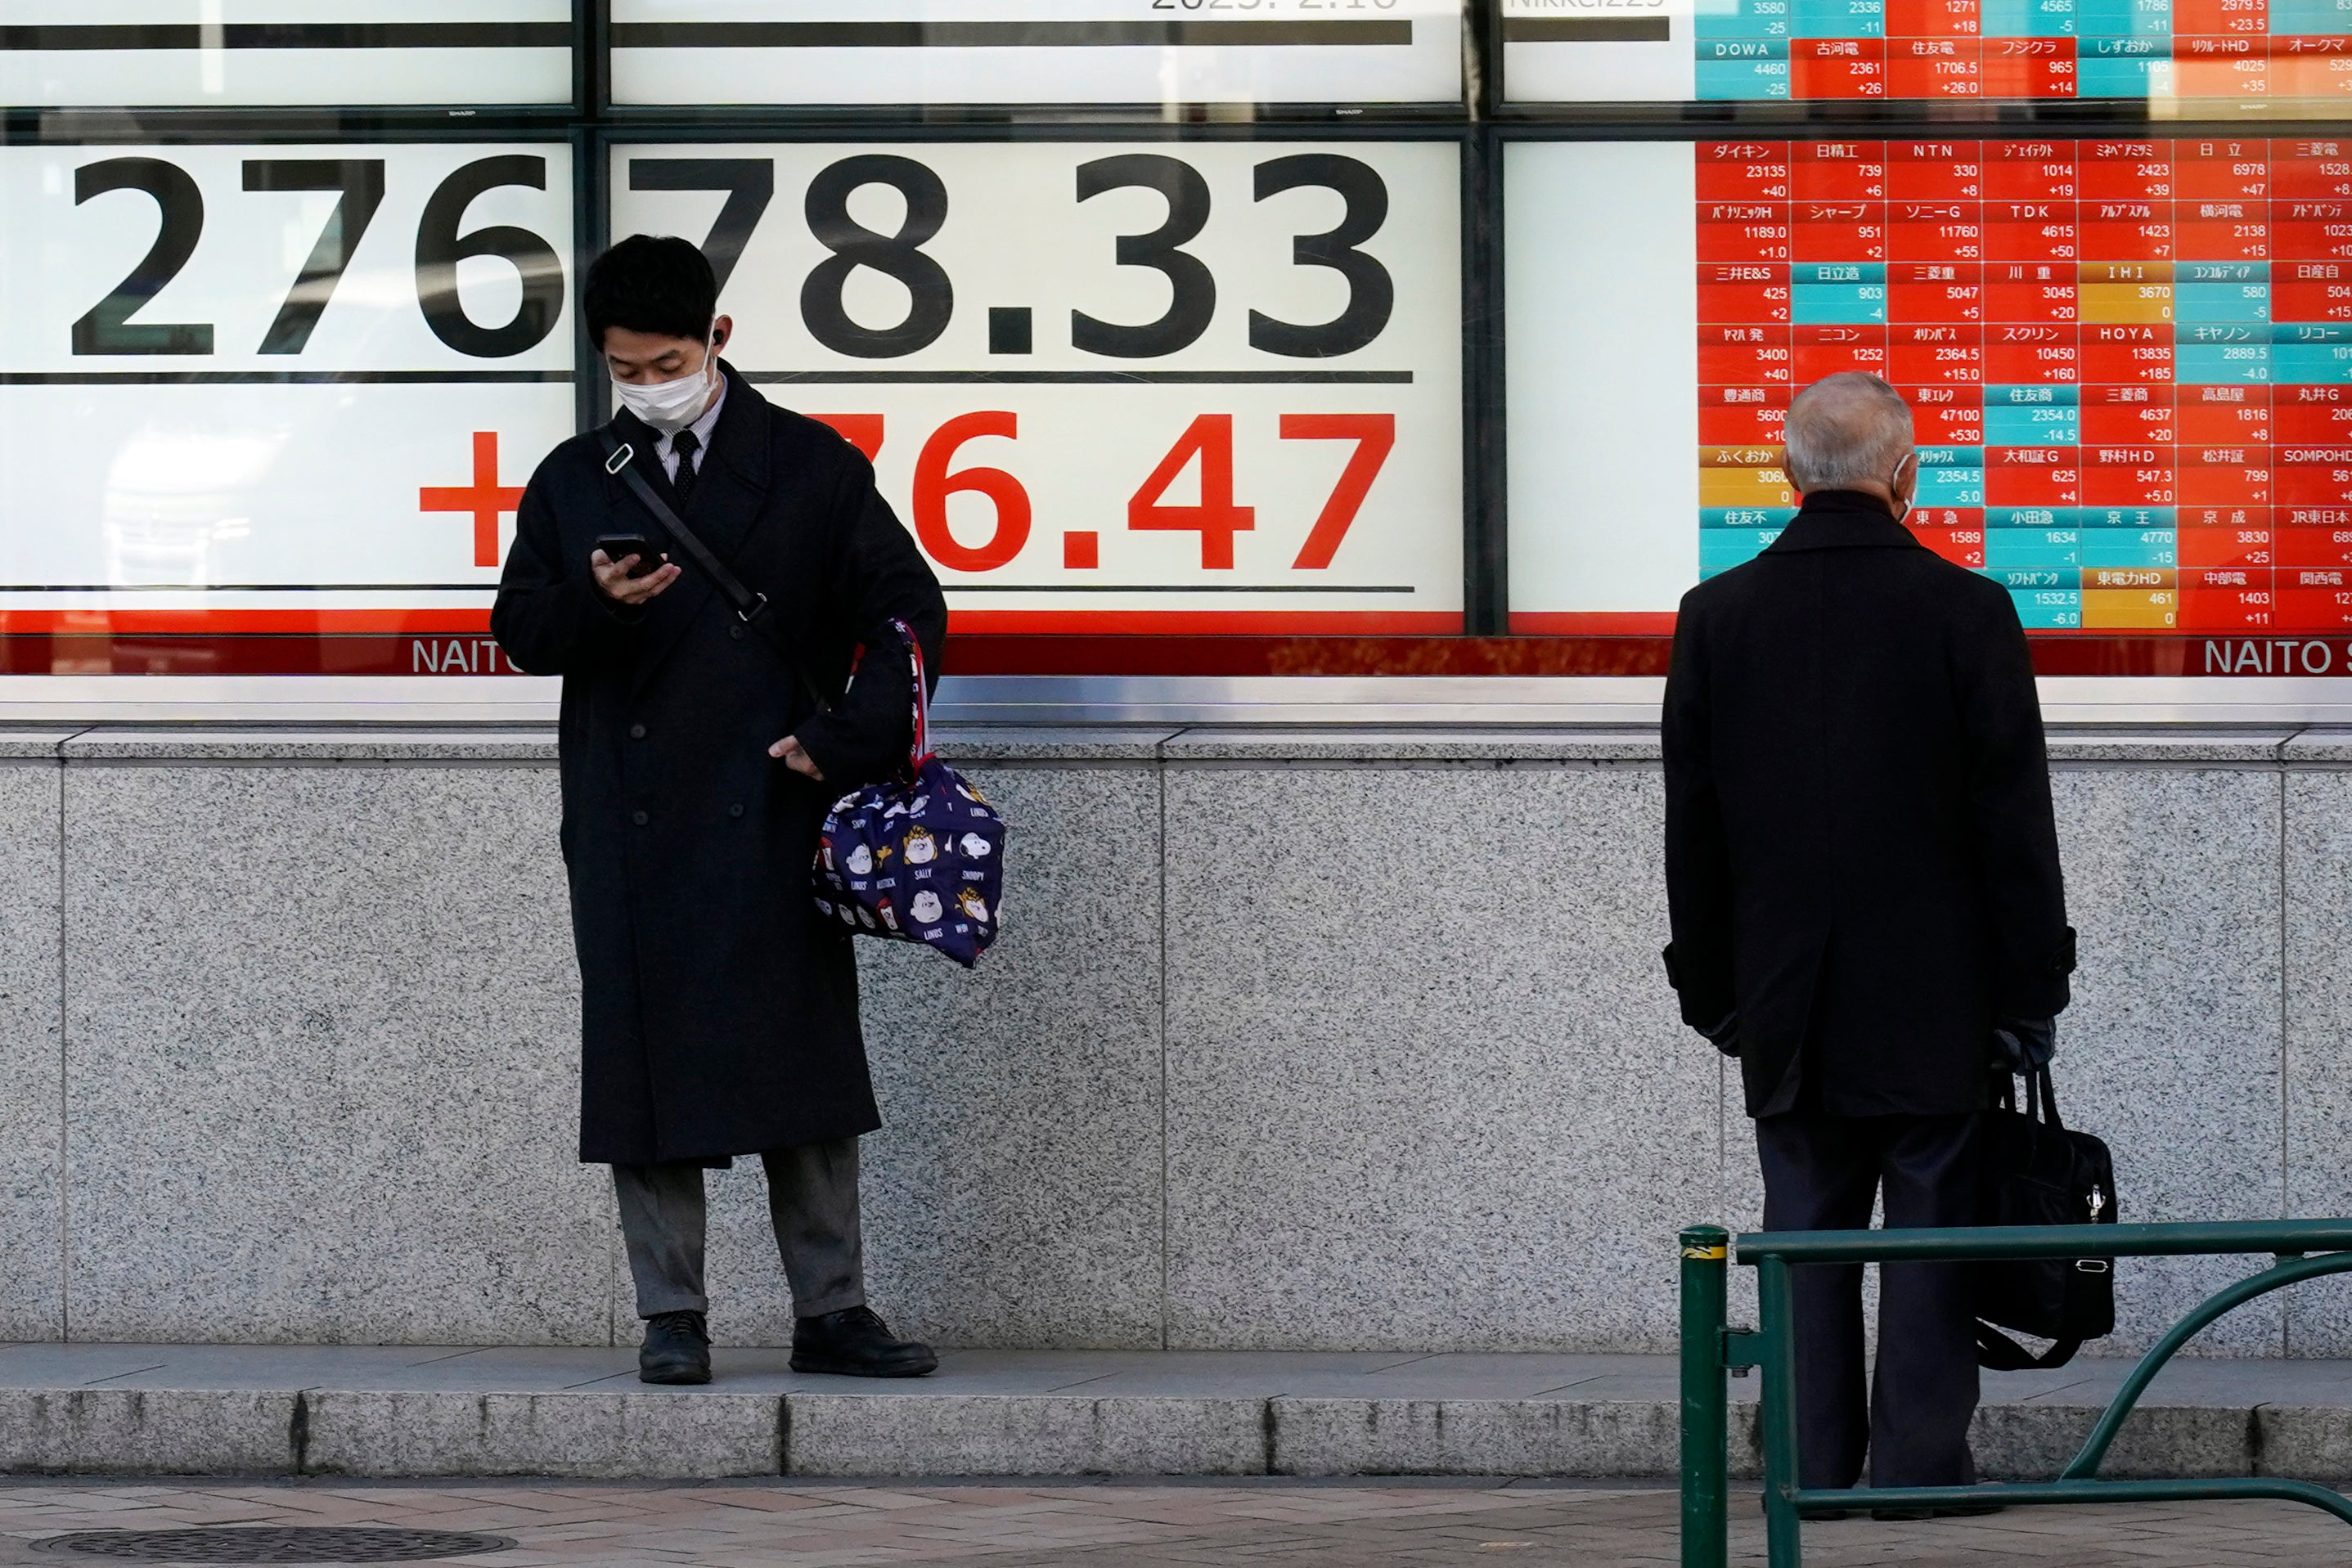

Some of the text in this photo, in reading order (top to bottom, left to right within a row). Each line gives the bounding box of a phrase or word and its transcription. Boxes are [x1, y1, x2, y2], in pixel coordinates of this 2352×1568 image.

[1754, 2, 1785, 14] 3580
[1850, 2, 1881, 13] 2336
[1946, 1, 1975, 12] 1271
[1765, 22, 1785, 34] -25
[1953, 20, 1976, 32] +18
[2060, 21, 2072, 33] -5
[2229, 19, 2265, 30] +23.5
[1716, 43, 1768, 56] DOWA
[1817, 42, 1859, 55] 古河電
[1912, 42, 1954, 54] 住友電
[2003, 42, 2056, 54] フジクラ
[2098, 40, 2152, 53] しずおか
[2290, 40, 2345, 52] オークマ
[1754, 63, 1786, 74] 4460
[1851, 62, 1879, 74] 2361
[1936, 62, 1977, 74] 1706.5
[2049, 61, 2073, 73] 965
[2233, 60, 2264, 71] 4025
[1766, 83, 1786, 95] -25
[1942, 82, 1977, 93] +26.0
[2050, 82, 2072, 92] +14
[1714, 145, 1770, 158] ダイキン
[1817, 144, 1858, 157] 日精工
[1914, 145, 1952, 156] NTN
[2296, 142, 2339, 156] 三菱電
[1747, 165, 1786, 177] 23135
[1859, 165, 1882, 177] 739
[1954, 164, 1977, 177] 330
[2043, 165, 2072, 176] 1014
[2137, 164, 2169, 176] 2423
[2233, 164, 2265, 175] 6978
[1762, 186, 1786, 196] +40
[1866, 185, 1882, 196] +6
[2049, 185, 2073, 195] +19
[2145, 184, 2169, 195] +39
[1810, 205, 1866, 218] シャープ
[1907, 206, 1960, 218] ソニーG
[2011, 206, 2048, 218] TDK
[2200, 204, 2243, 218] 横河電
[1745, 227, 1786, 238] 1189.0
[1859, 227, 1880, 238] 951
[1940, 226, 1978, 237] 11760
[2042, 226, 2074, 237] 4615
[2139, 225, 2170, 236] 1423
[2234, 225, 2265, 236] 2138
[71, 154, 1394, 358] 27678.33
[1760, 246, 1787, 258] +1.0
[1867, 246, 1882, 258] +2
[2050, 245, 2074, 257] +50
[2154, 245, 2170, 256] +7
[1716, 267, 1770, 280] 三井E&S
[1819, 267, 1860, 280] 日立造
[1914, 267, 1954, 280] 三菱重
[2109, 267, 2143, 278] IHI
[2298, 265, 2338, 278] 日産自
[1763, 288, 1787, 299] 425
[1859, 288, 1882, 299] 903
[1947, 287, 1978, 299] 5047
[2043, 286, 2075, 299] 3045
[2138, 286, 2170, 298] 3670
[2242, 286, 2266, 298] 580
[1771, 308, 1787, 319] +2
[1870, 308, 1882, 319] -4
[2051, 307, 2075, 318] +20
[2254, 308, 2266, 319] -5
[1818, 329, 1860, 341] ニコン
[2003, 328, 2058, 340] スクリン
[2101, 328, 2152, 339] HOYA
[2195, 327, 2250, 340] キヤノン
[2300, 327, 2339, 339] リコー
[1756, 349, 1788, 360] 3400
[1853, 348, 1883, 360] 1252
[1936, 348, 1979, 360] 2364.5
[2036, 348, 2075, 360] 10450
[2133, 348, 2171, 359] 13835
[2224, 348, 2267, 359] 2889.5
[1764, 369, 1788, 380] +40
[2044, 368, 2075, 380] +160
[2139, 367, 2170, 379] +185
[1725, 389, 1765, 402] 豊通商
[2010, 388, 2052, 402] 住友商
[2107, 388, 2147, 402] 三菱商
[2202, 387, 2243, 401] 高島屋
[2299, 388, 2338, 401] 丸井G
[1757, 410, 1787, 421] 5600
[1941, 410, 1979, 421] 47100
[2032, 409, 2075, 421] 2354.0
[2140, 409, 2171, 420] 4637
[2237, 409, 2268, 420] 1816
[1949, 429, 1979, 441] +530
[2044, 429, 2075, 441] -14.5
[2251, 429, 2268, 440] +8
[1717, 450, 1773, 463] ふくおか
[2004, 450, 2058, 463] 大和証G
[2100, 449, 2154, 462] 野村HD
[2203, 450, 2245, 462] 松井証
[1936, 471, 1980, 483] 2354.5
[2053, 470, 2075, 482] 625
[2137, 470, 2172, 482] 547.3
[2245, 470, 2268, 481] 799
[1781, 491, 1789, 502] 0
[2060, 491, 2075, 501] +4
[2145, 490, 2172, 501] +5.0
[1725, 511, 1766, 524] 住友不
[2011, 510, 2053, 523] 小田急
[2291, 510, 2349, 523] JR東日本
[1950, 532, 1981, 543] 1589
[2046, 532, 2076, 543] 1634
[2140, 532, 2172, 543] 4770
[2237, 531, 2269, 542] 3830
[1965, 551, 1981, 563] +2
[2063, 552, 2075, 563] -1
[2246, 551, 2269, 563] +25
[2099, 572, 2161, 585] 東電力HD
[2205, 572, 2246, 585] 中部電
[2301, 572, 2342, 584] 関西電
[2032, 593, 2076, 604] 1532.5
[2149, 593, 2171, 604] 461
[2239, 592, 2269, 604] 1403
[2053, 613, 2077, 625] -6.0
[2246, 613, 2268, 624] +11
[2205, 640, 2332, 673] NAITO
